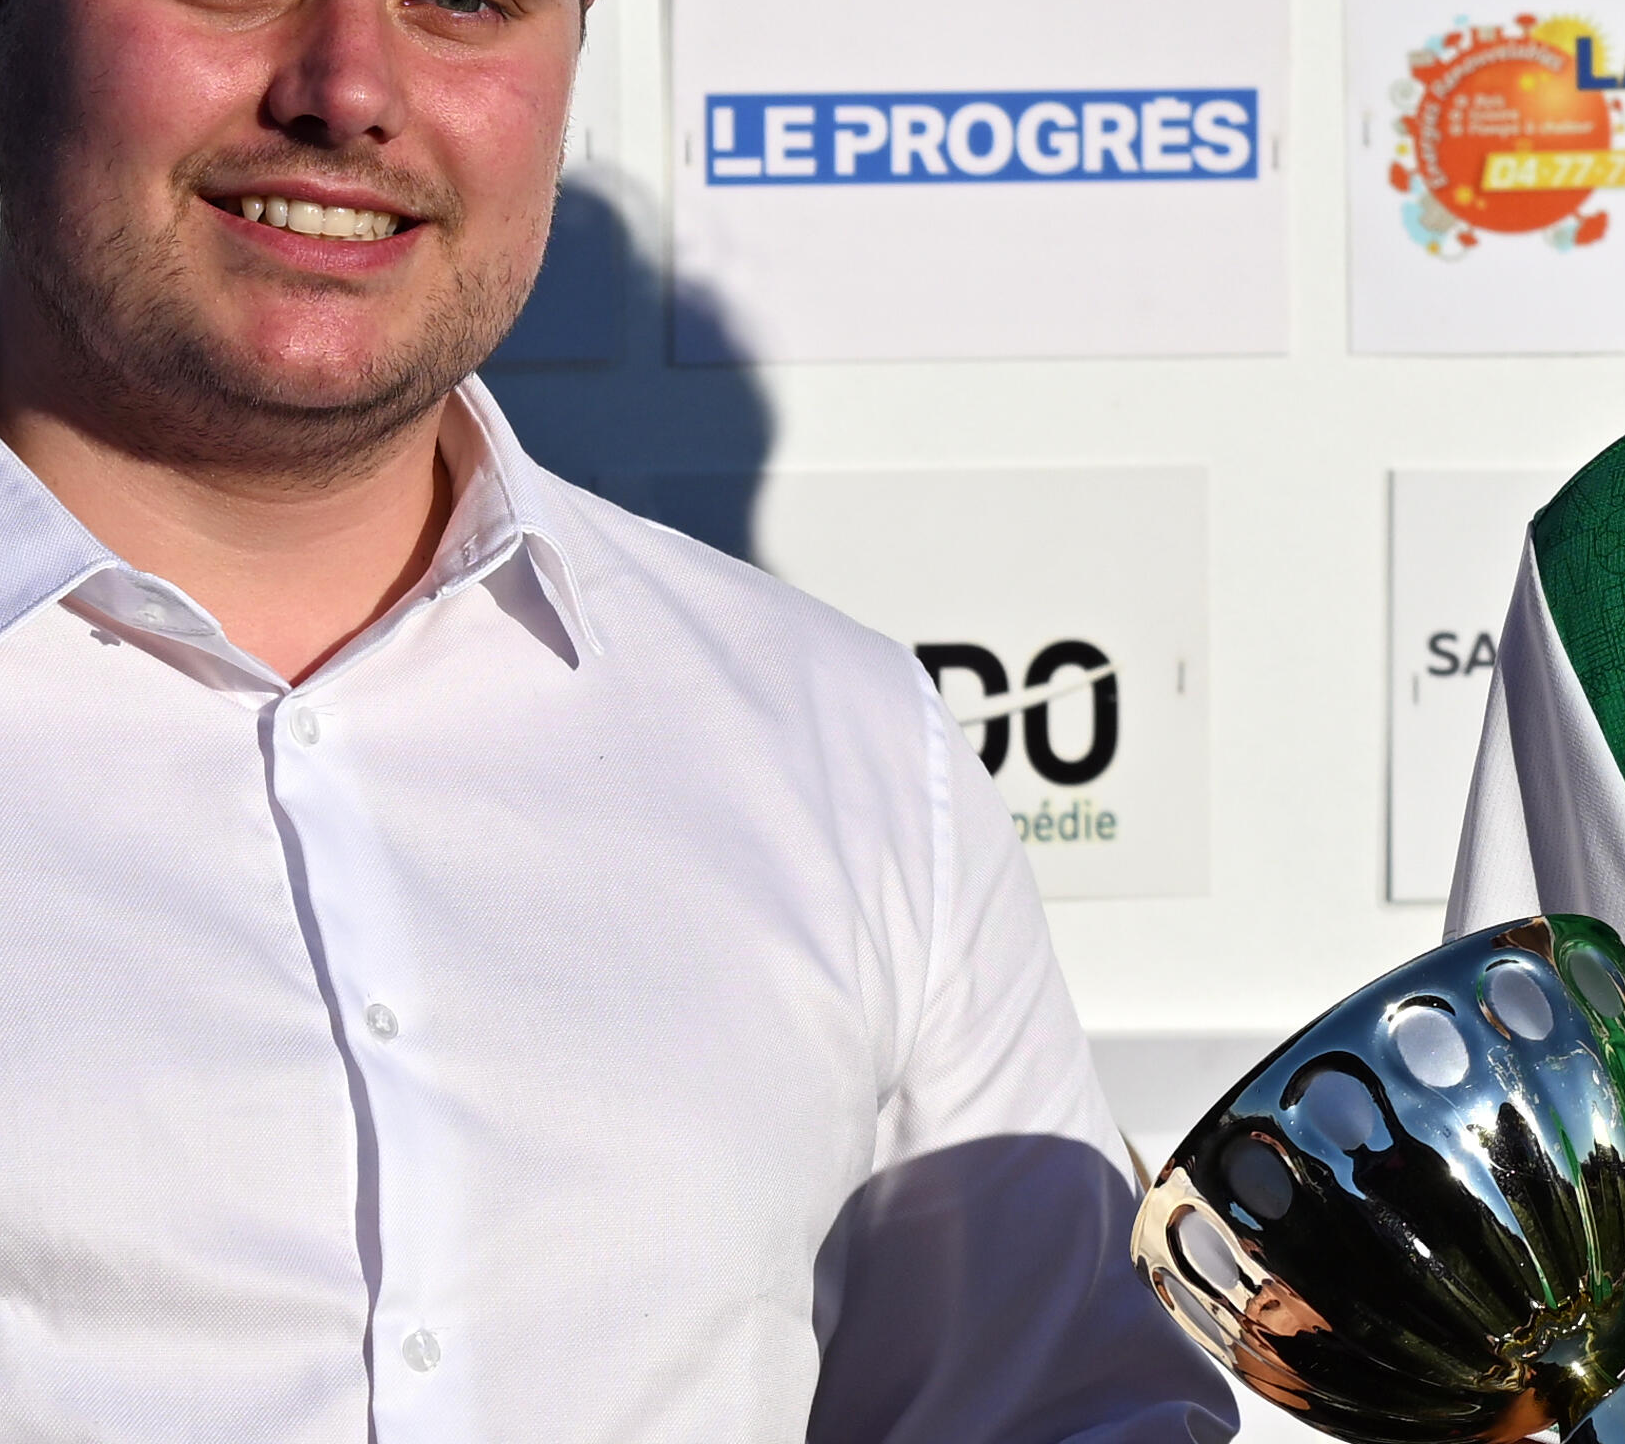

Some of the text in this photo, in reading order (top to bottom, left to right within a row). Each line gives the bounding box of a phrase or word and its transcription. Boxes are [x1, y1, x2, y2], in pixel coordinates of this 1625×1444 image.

[713, 98, 1252, 177] LE PROGRÈS
[914, 638, 1120, 786] DO
